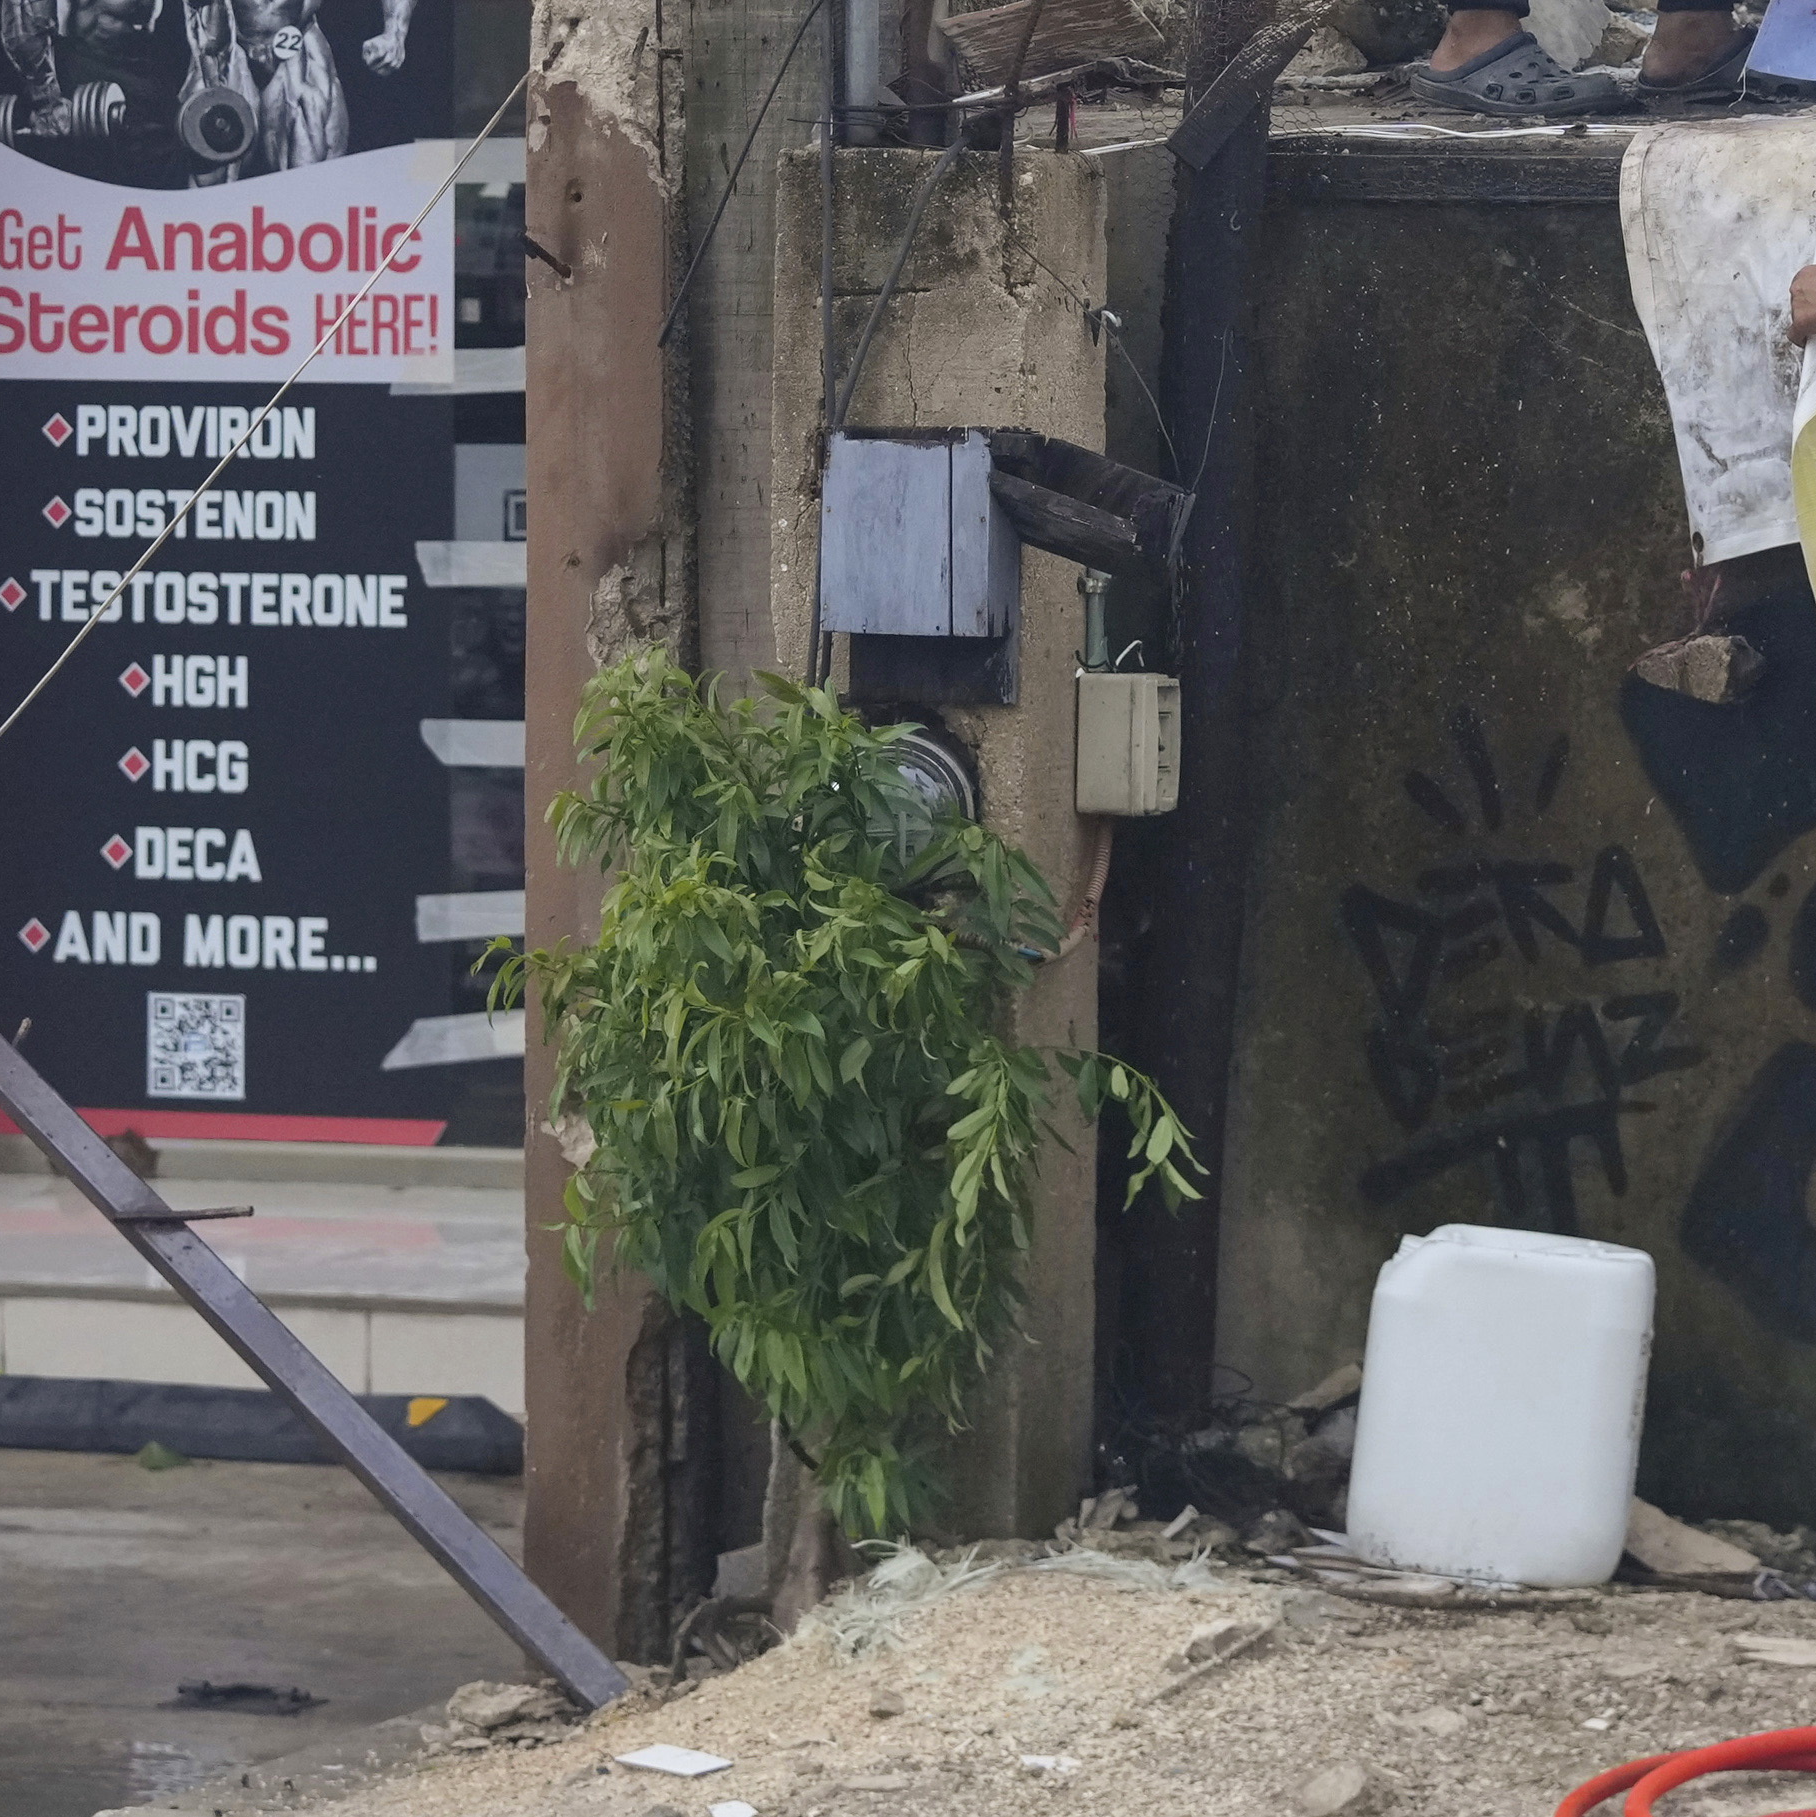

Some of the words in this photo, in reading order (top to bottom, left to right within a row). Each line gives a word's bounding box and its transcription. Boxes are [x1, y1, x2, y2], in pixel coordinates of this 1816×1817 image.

[275, 32, 301, 52] 22
[107, 206, 423, 273] Anabolic
[315, 293, 439, 357] HERE!
[76, 403, 315, 460] PROVIRON
[73, 488, 316, 541] SOSTENON
[31, 569, 408, 629] TESTOSTERONE
[152, 654, 249, 709] HGH
[153, 740, 249, 794] HCG
[135, 827, 263, 884] DECA
[54, 911, 161, 965] AND
[185, 915, 378, 972] MORE...
